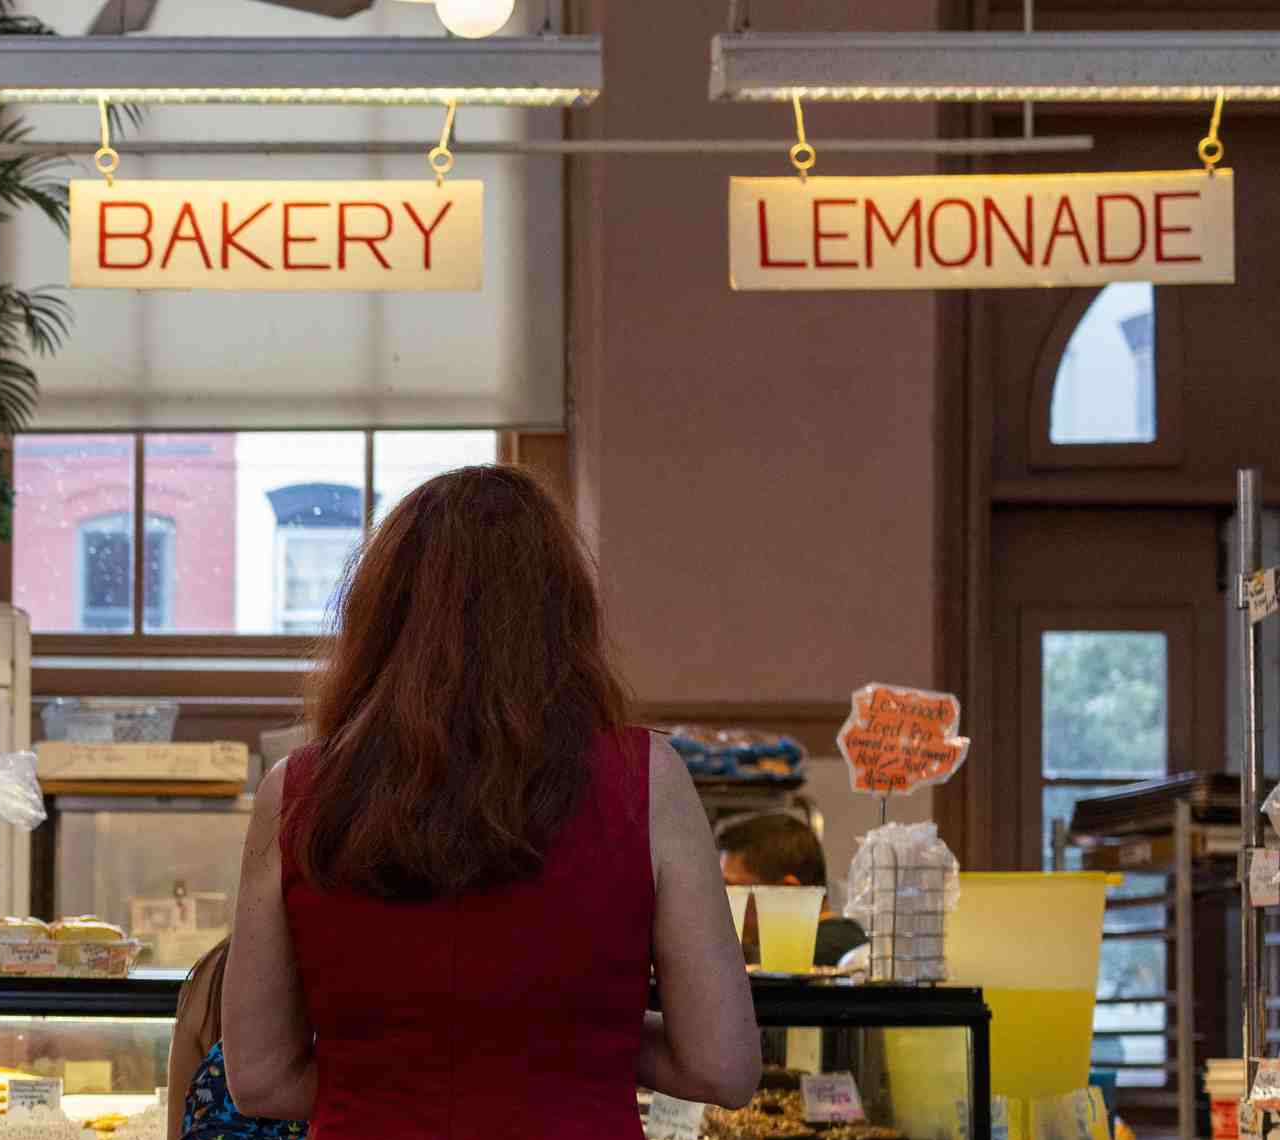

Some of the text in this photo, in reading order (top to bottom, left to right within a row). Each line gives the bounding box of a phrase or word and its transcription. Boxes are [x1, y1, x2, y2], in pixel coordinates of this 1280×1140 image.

[96, 199, 454, 272] BAKERY
[757, 190, 1203, 270] LEMONADE
[866, 719, 905, 737] Iced
[869, 690, 951, 722] Lemonade
